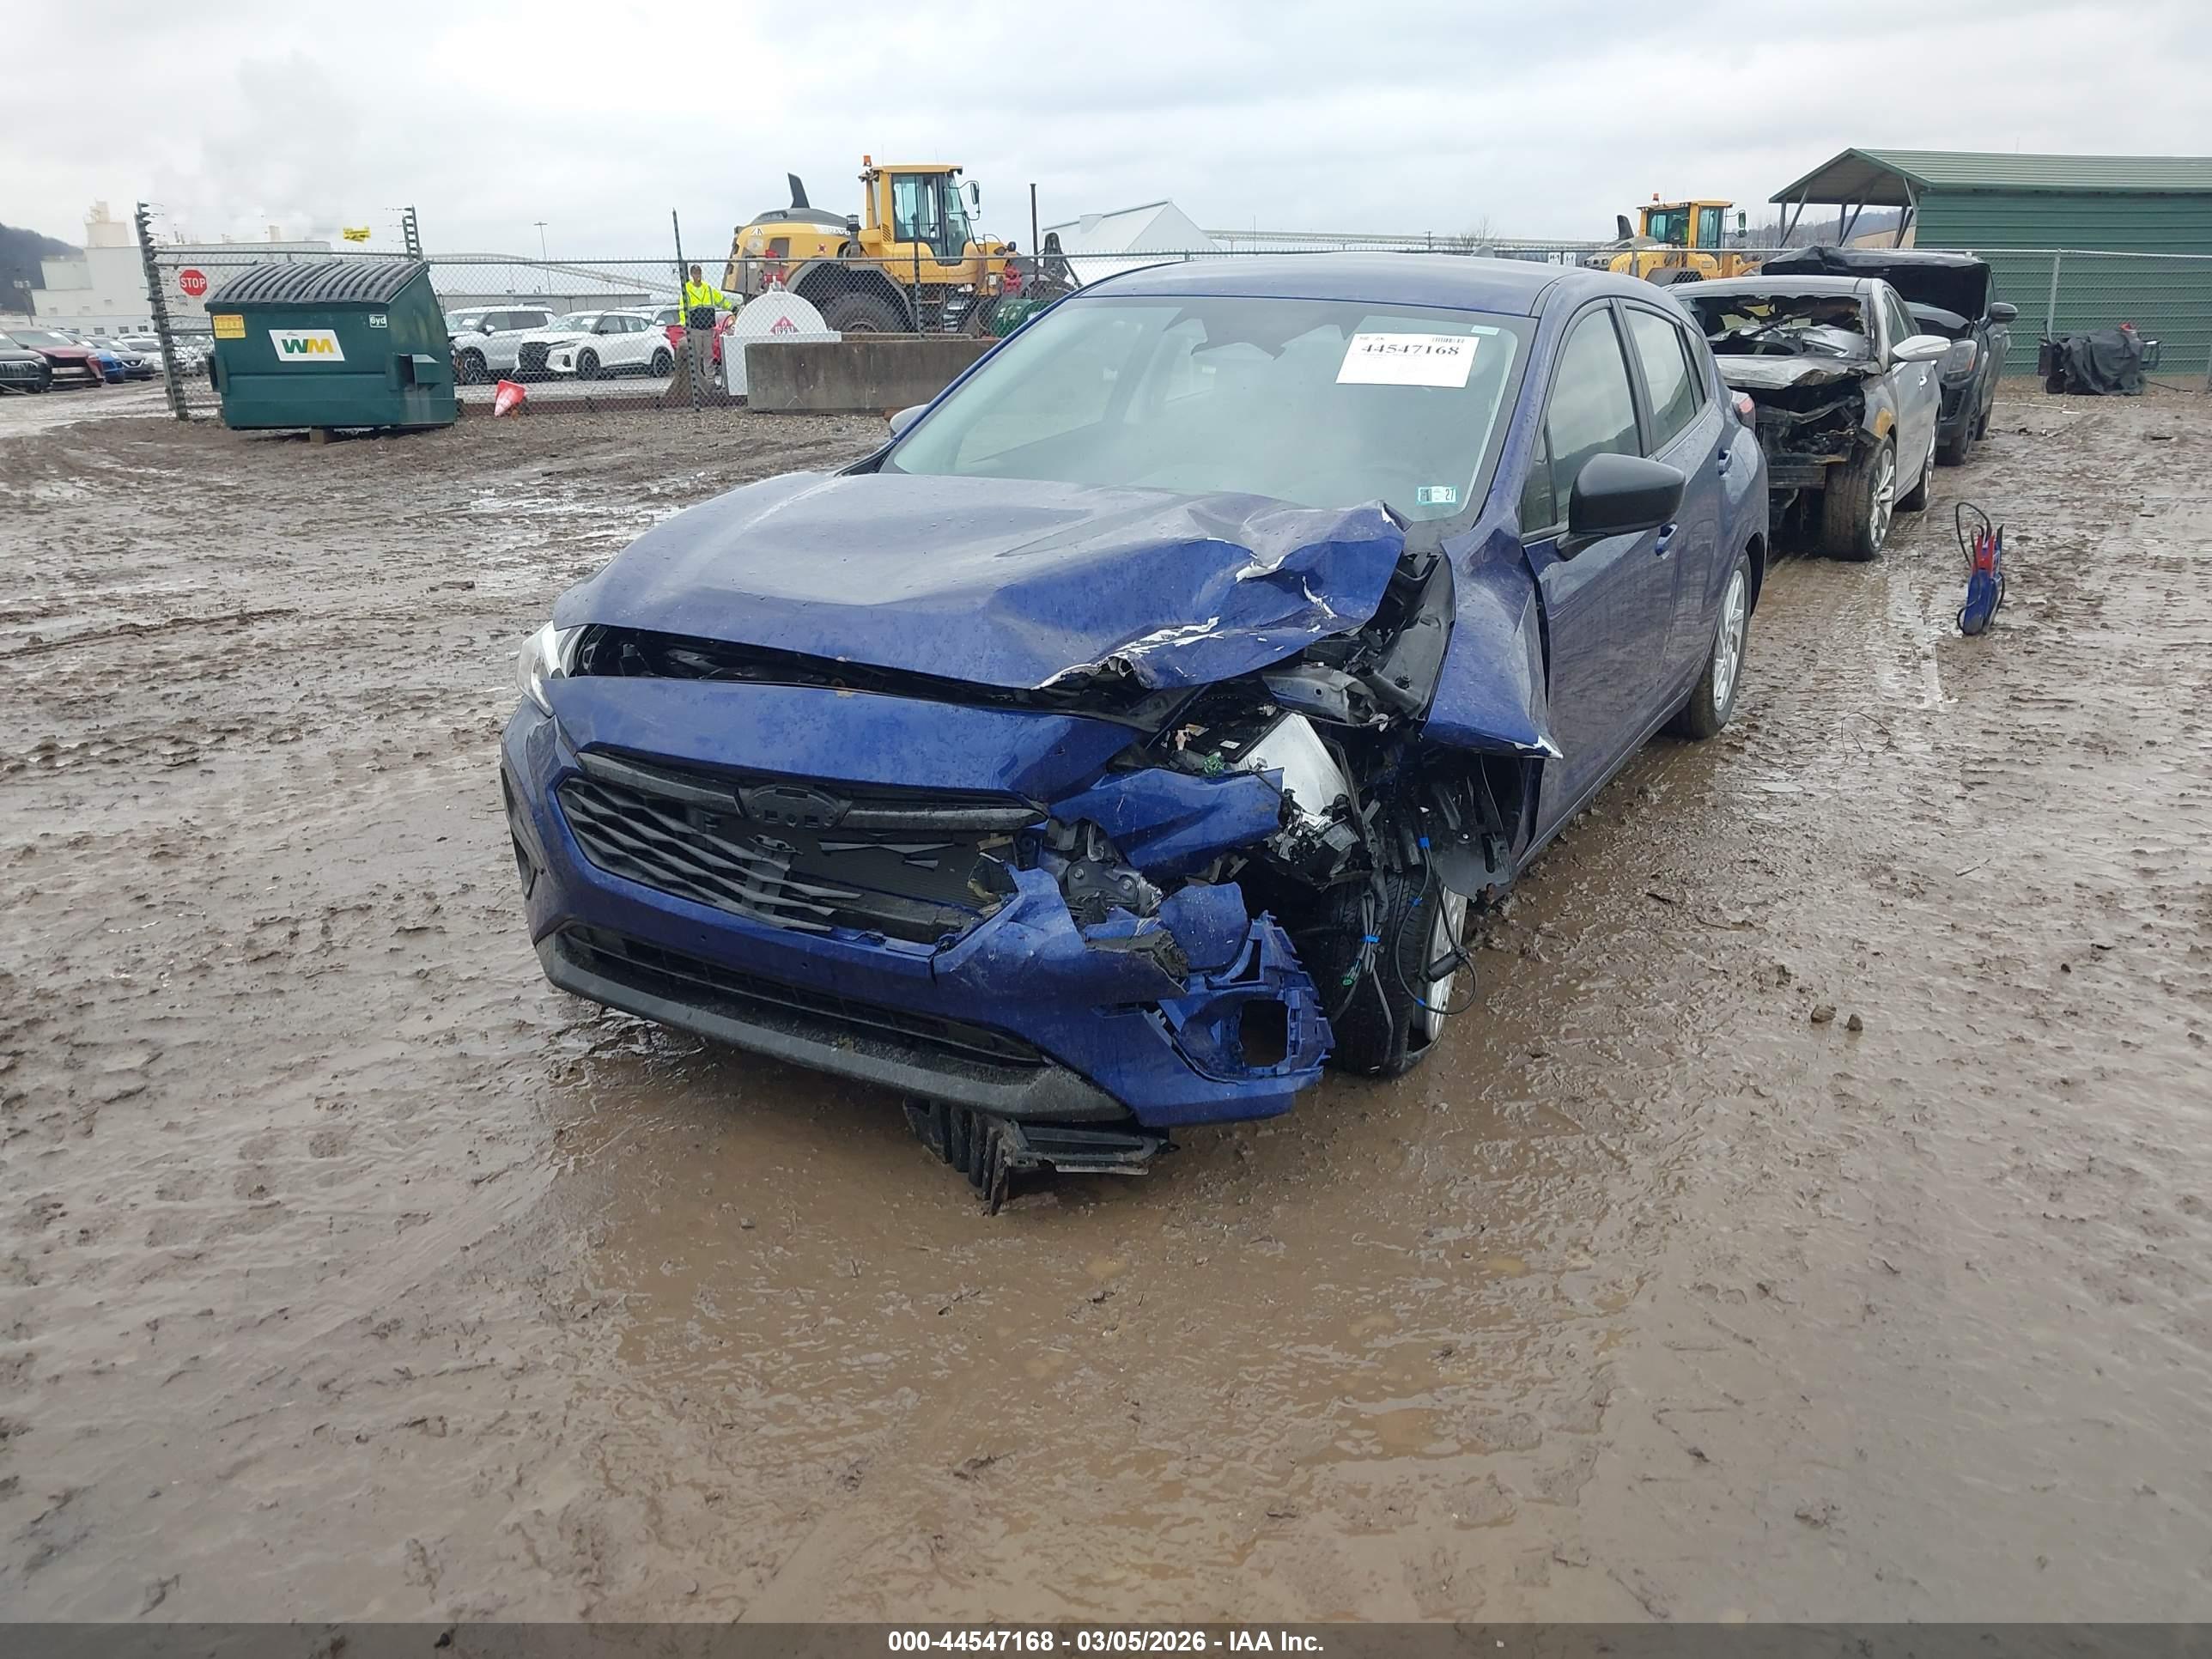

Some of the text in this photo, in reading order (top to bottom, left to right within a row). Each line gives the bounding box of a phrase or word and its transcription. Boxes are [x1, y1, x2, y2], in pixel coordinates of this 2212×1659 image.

[180, 276, 206, 289] STOP
[281, 338, 334, 354] WM
[1362, 344, 1459, 356] 44547168
[1445, 488, 1455, 501] 27
